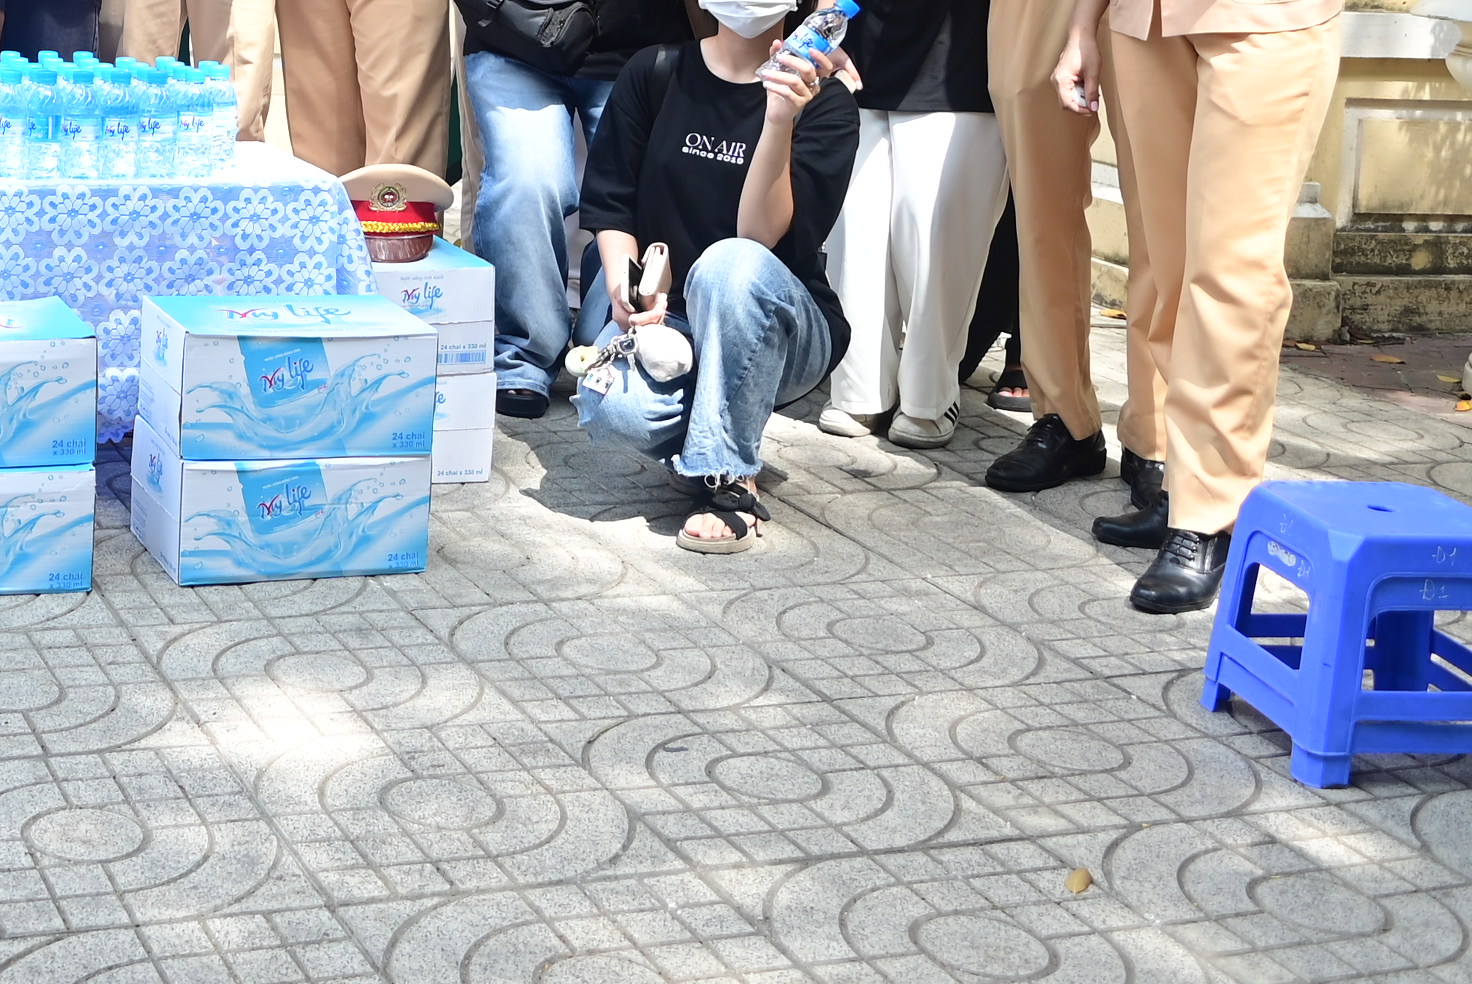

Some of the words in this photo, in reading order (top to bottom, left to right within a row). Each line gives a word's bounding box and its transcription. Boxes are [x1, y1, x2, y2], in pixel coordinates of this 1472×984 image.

[0, 116, 12, 135] life
[69, 121, 82, 140] life
[117, 122, 131, 141] life
[147, 116, 161, 136] life
[685, 132, 715, 151] ON
[715, 140, 747, 158] AIR
[716, 152, 744, 165] 2019
[400, 287, 420, 304] My
[423, 281, 443, 310] life
[285, 304, 351, 325] life
[259, 367, 286, 393] My
[287, 357, 314, 390] life
[52, 439, 65, 448] 24
[66, 438, 86, 448] chai
[392, 432, 405, 441] 24
[406, 431, 425, 441] chai
[415, 440, 425, 448] ml
[59, 448, 75, 456] 330
[76, 447, 86, 455] ml
[257, 494, 284, 519] My
[284, 483, 312, 517] life
[388, 553, 400, 562] 24
[401, 552, 419, 561] chai
[48, 572, 61, 581] 24
[63, 571, 83, 581] chai
